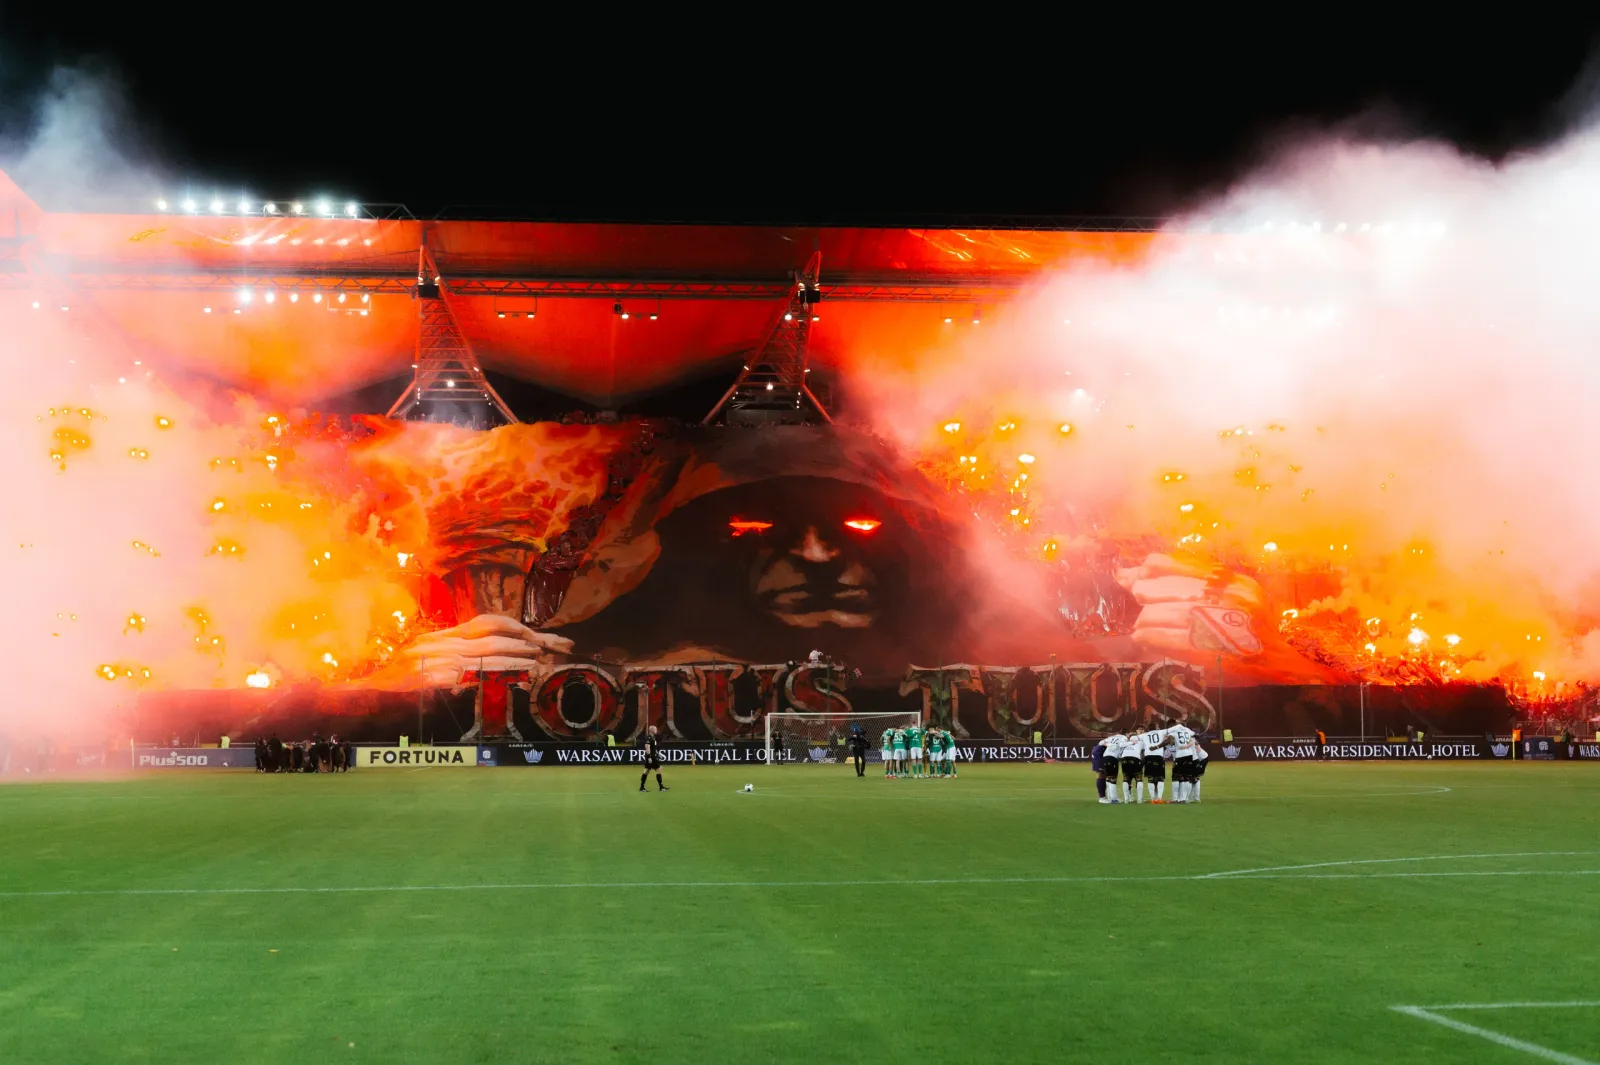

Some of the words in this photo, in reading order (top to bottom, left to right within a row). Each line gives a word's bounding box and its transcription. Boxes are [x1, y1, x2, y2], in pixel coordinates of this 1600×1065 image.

[451, 663, 853, 743] TOTUS
[898, 657, 1217, 742] TUUS
[1147, 733, 1160, 744] 10
[370, 750, 464, 764] FORTUNA
[556, 749, 625, 762] WARSAW
[629, 749, 742, 761] PRSIDENTIAL
[981, 746, 1090, 759] PRESIDENTIAL
[1253, 745, 1318, 758] WARSAW
[1322, 744, 1428, 757] PRESIDENTIAL
[1431, 744, 1480, 757] HOTEL
[139, 751, 208, 766] Plus500
